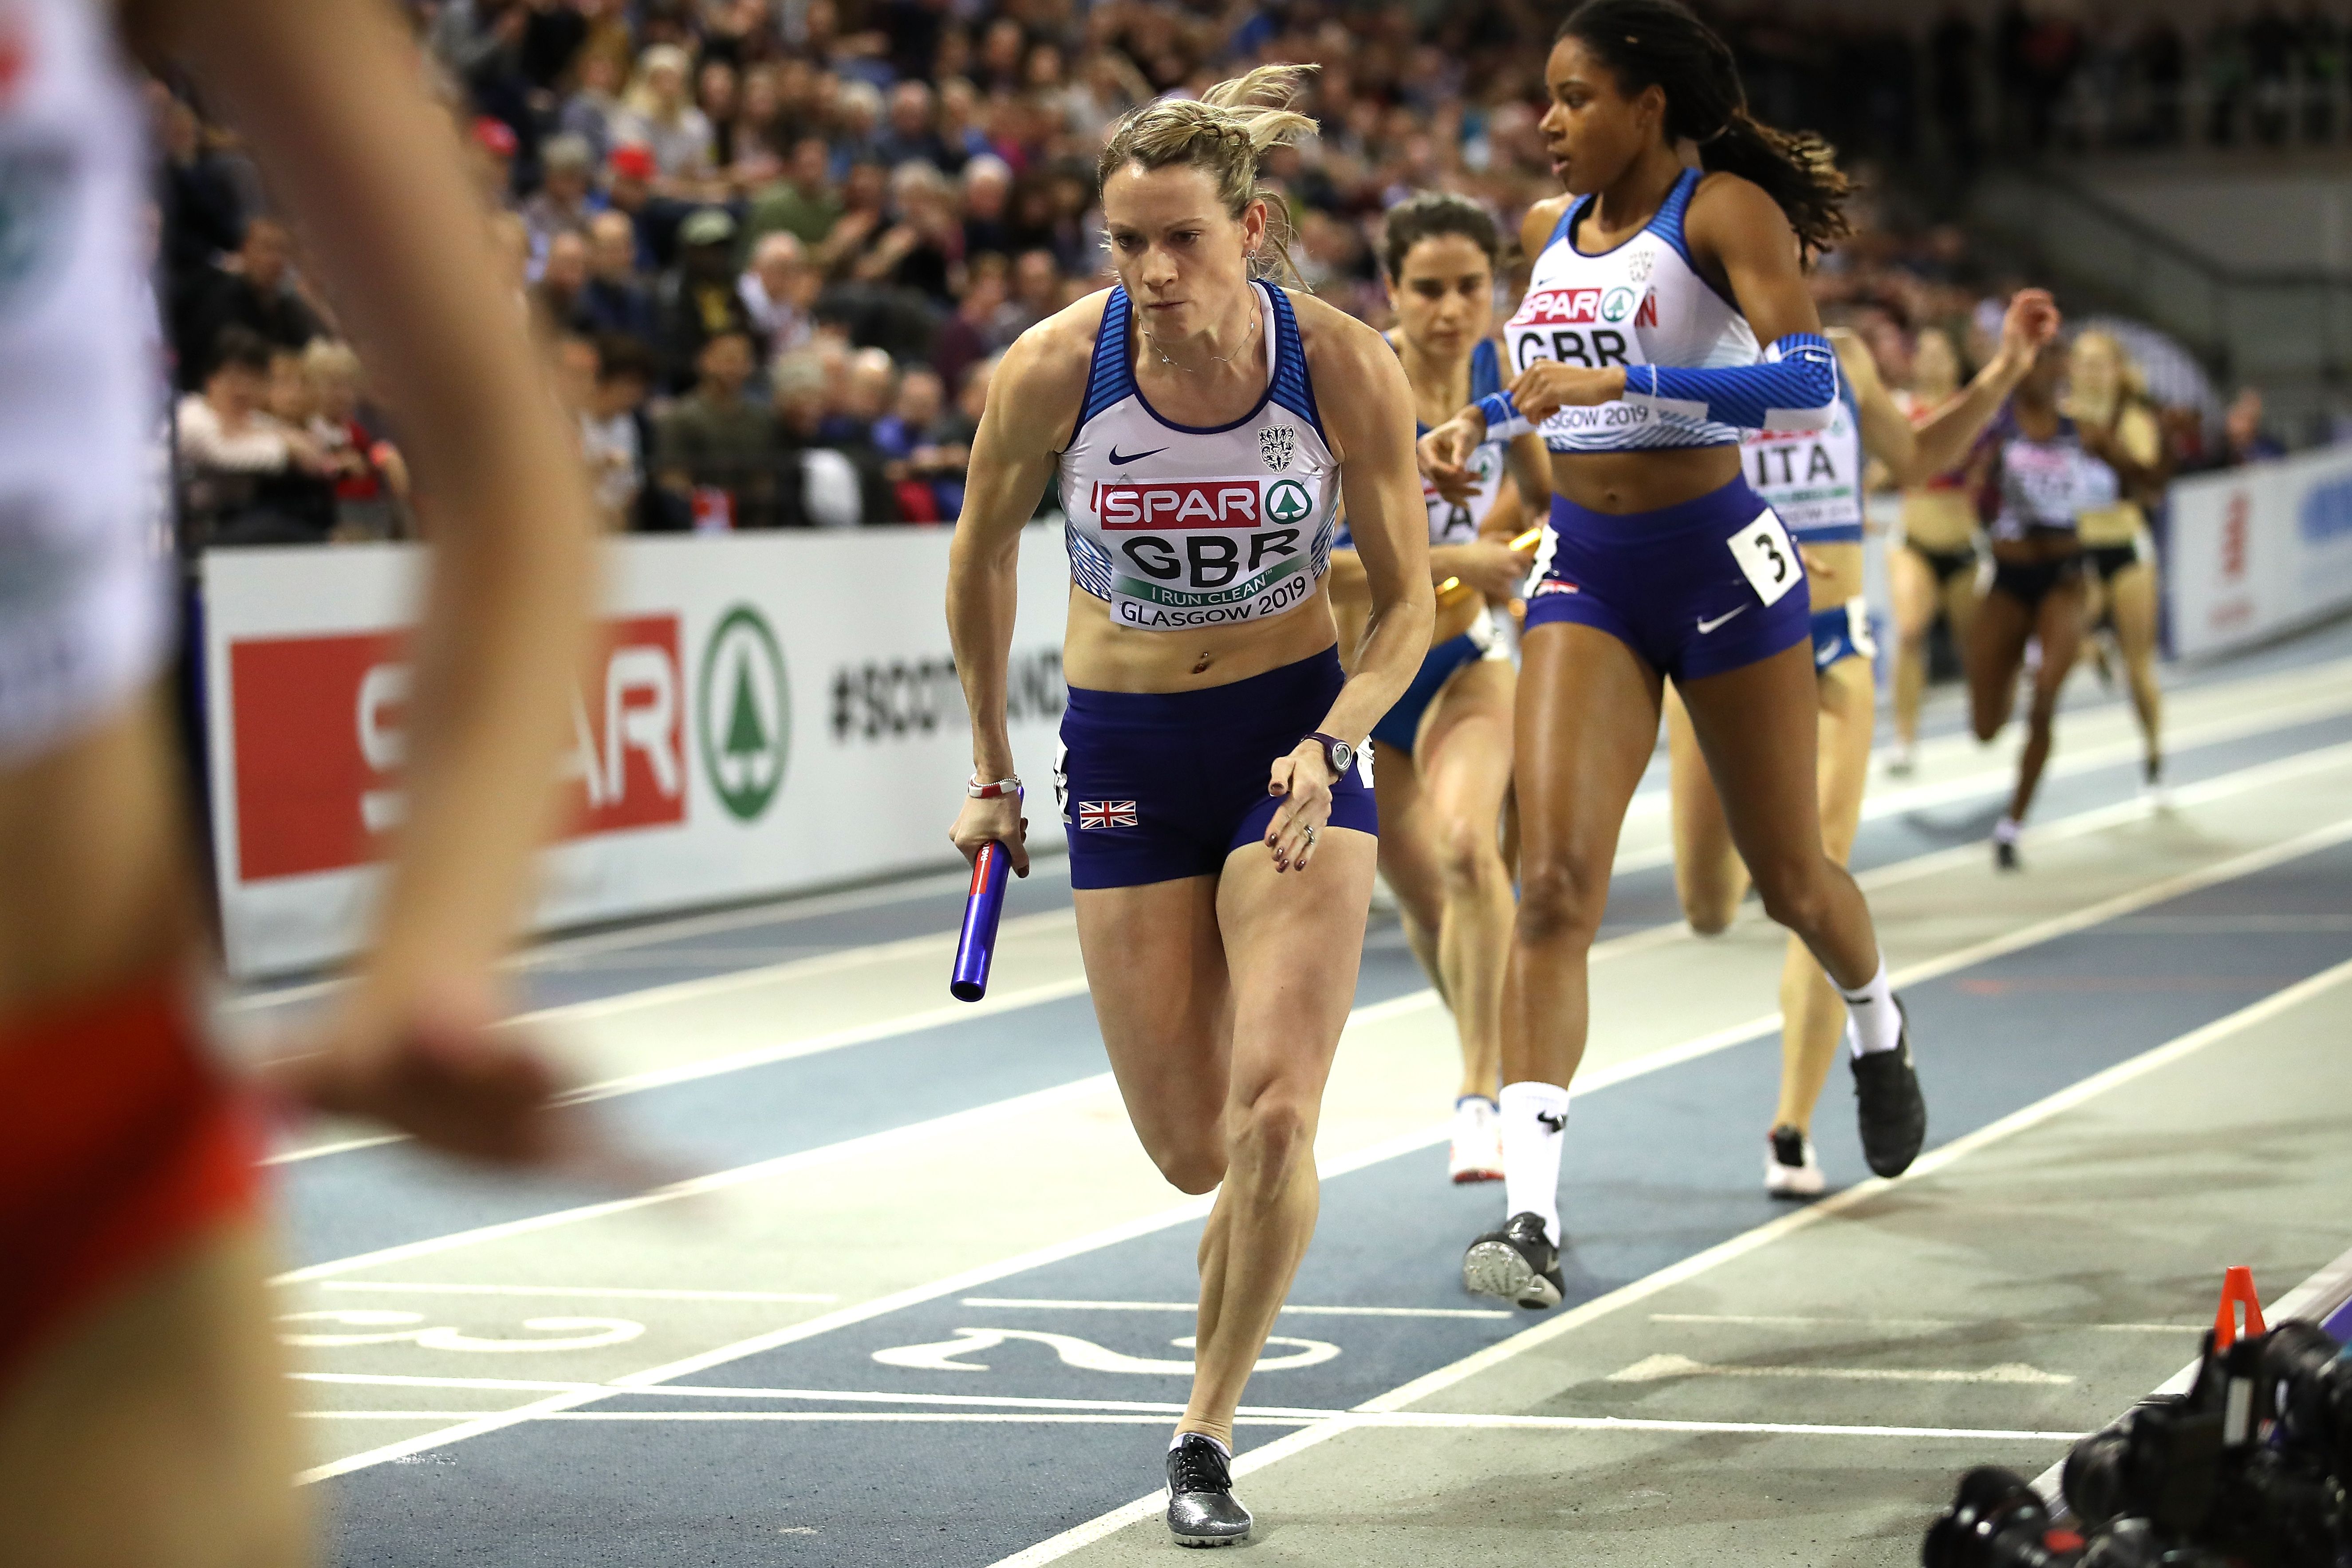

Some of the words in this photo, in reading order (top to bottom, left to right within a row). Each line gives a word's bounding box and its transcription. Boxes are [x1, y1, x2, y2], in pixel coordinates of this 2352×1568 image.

[1519, 330, 1631, 368] GBR
[1605, 404, 1648, 426] 2019
[1757, 445, 1836, 486] ITA
[1105, 489, 1257, 523] SPAR
[1122, 529, 1300, 588] GBR
[1755, 533, 1786, 584] 3
[1121, 600, 1253, 627] GLASGOW
[1258, 576, 1306, 615] 2019
[1152, 587, 1156, 600] I
[1161, 590, 1202, 605] RUN
